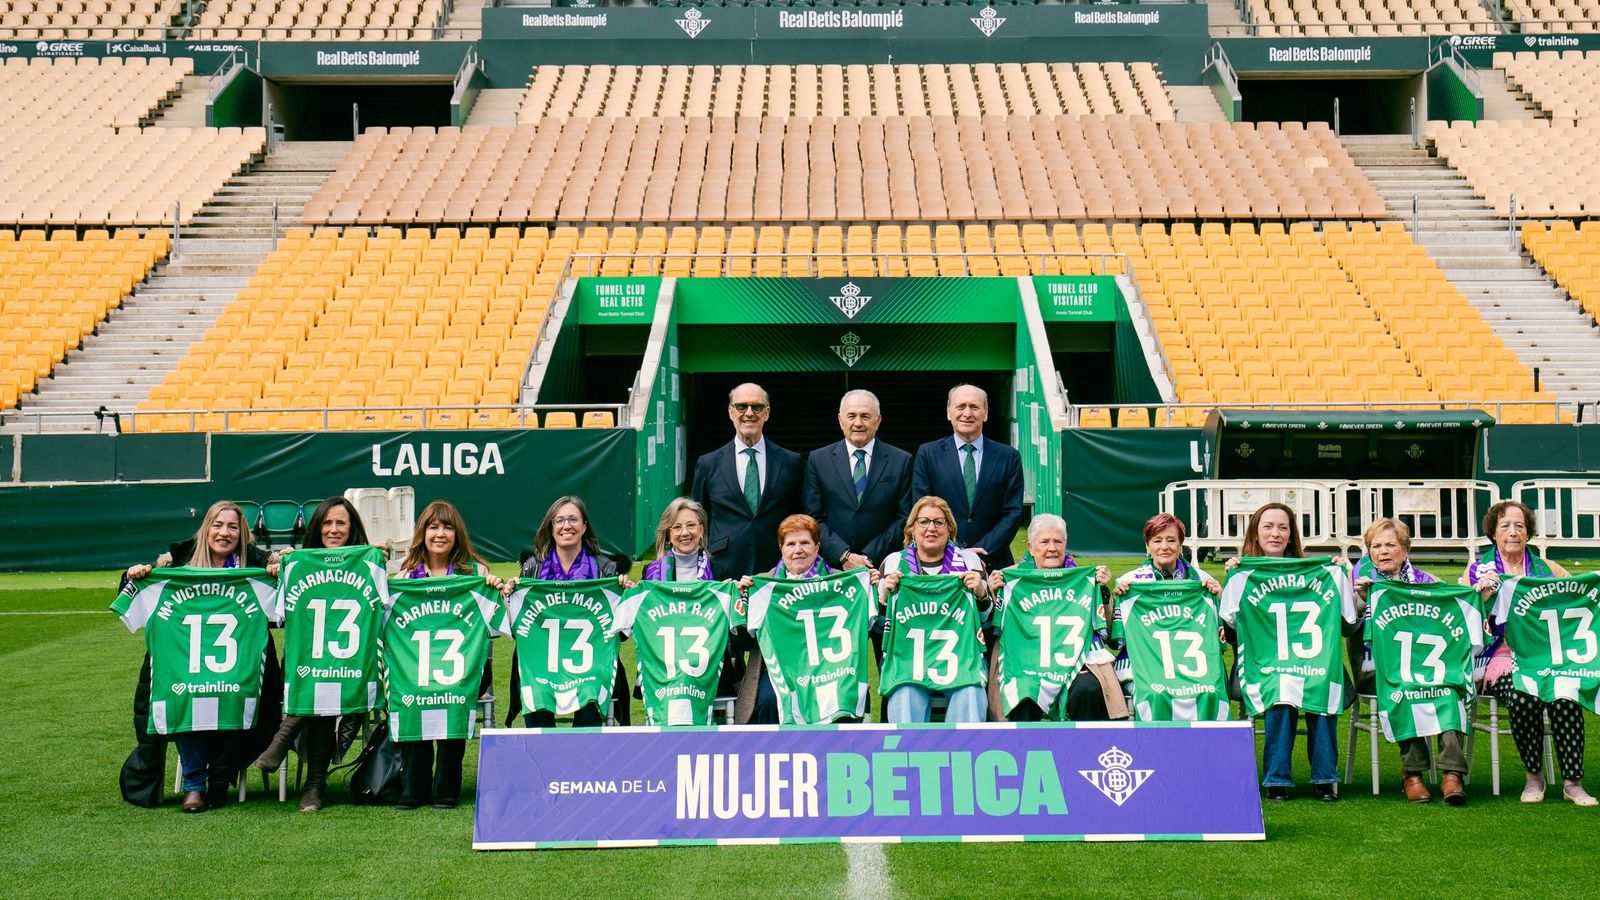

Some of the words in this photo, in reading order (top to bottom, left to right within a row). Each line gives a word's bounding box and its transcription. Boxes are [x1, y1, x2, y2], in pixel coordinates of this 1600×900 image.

[522, 14, 542, 26] Real
[542, 14, 564, 26] Betis
[565, 14, 607, 28] Balompié
[780, 10, 808, 28] Real
[808, 10, 841, 28] Betis
[842, 10, 903, 30] Balompié
[1074, 12, 1094, 24] Real
[1094, 12, 1116, 24] Betis
[1117, 10, 1159, 25] Balompié
[49, 42, 84, 52] GREE
[122, 44, 162, 52] CaixaBank
[1462, 36, 1496, 46] GREE
[1538, 36, 1579, 46] trainline
[317, 51, 340, 65] Real
[341, 51, 368, 65] Betis
[368, 50, 420, 68] Balompié
[1270, 47, 1292, 62] Real
[1293, 47, 1320, 62] Betis
[1320, 46, 1371, 63] Balompié
[595, 284, 624, 296] TUNNEL
[626, 284, 646, 296] CLUB
[1048, 283, 1076, 294] TUNNEL
[1078, 283, 1098, 294] CLUB
[600, 296, 618, 308] REAL
[621, 296, 643, 308] BETIS
[1053, 295, 1092, 306] VISITANTE
[372, 442, 505, 476] LALIGA
[171, 583, 235, 604] VICTORIA
[284, 569, 366, 612] ENCARNACION
[778, 580, 828, 610] PAQUITA
[1020, 588, 1063, 612] MARIA
[1247, 574, 1306, 606] AZAHARA
[1514, 581, 1588, 616] CONCEPCION
[395, 600, 450, 629] CARMEN
[516, 600, 546, 638] MARIA
[545, 592, 569, 606] DEL
[572, 592, 603, 615] MAR
[647, 602, 687, 622] PILAR
[896, 602, 938, 624] SALUD
[1140, 605, 1181, 627] SALUD
[1375, 603, 1440, 630] MERCEDES
[306, 599, 361, 659] 13
[796, 606, 852, 666] 13
[1268, 601, 1322, 661] 13
[1539, 607, 1597, 665] 13
[182, 614, 238, 674] 13
[542, 618, 594, 674] 13
[656, 626, 710, 679] 13
[1032, 616, 1085, 668] 13
[410, 629, 465, 687] 13
[906, 628, 959, 685] 13
[1152, 631, 1208, 680] 13
[1393, 631, 1447, 684] 13
[312, 666, 362, 678] trainline
[811, 667, 856, 684] trainline
[1276, 665, 1326, 676] trainline
[188, 681, 240, 694] trainline
[549, 676, 596, 690] trainline
[666, 683, 706, 699] trainline
[1166, 684, 1216, 696] trainline
[1406, 686, 1451, 700] trainline
[416, 692, 466, 706] trainline
[549, 781, 618, 794] SEMANA
[622, 780, 642, 793] DE
[647, 780, 666, 793] LA
[676, 752, 818, 820] MUJER
[826, 736, 1069, 817] BÉTICA
